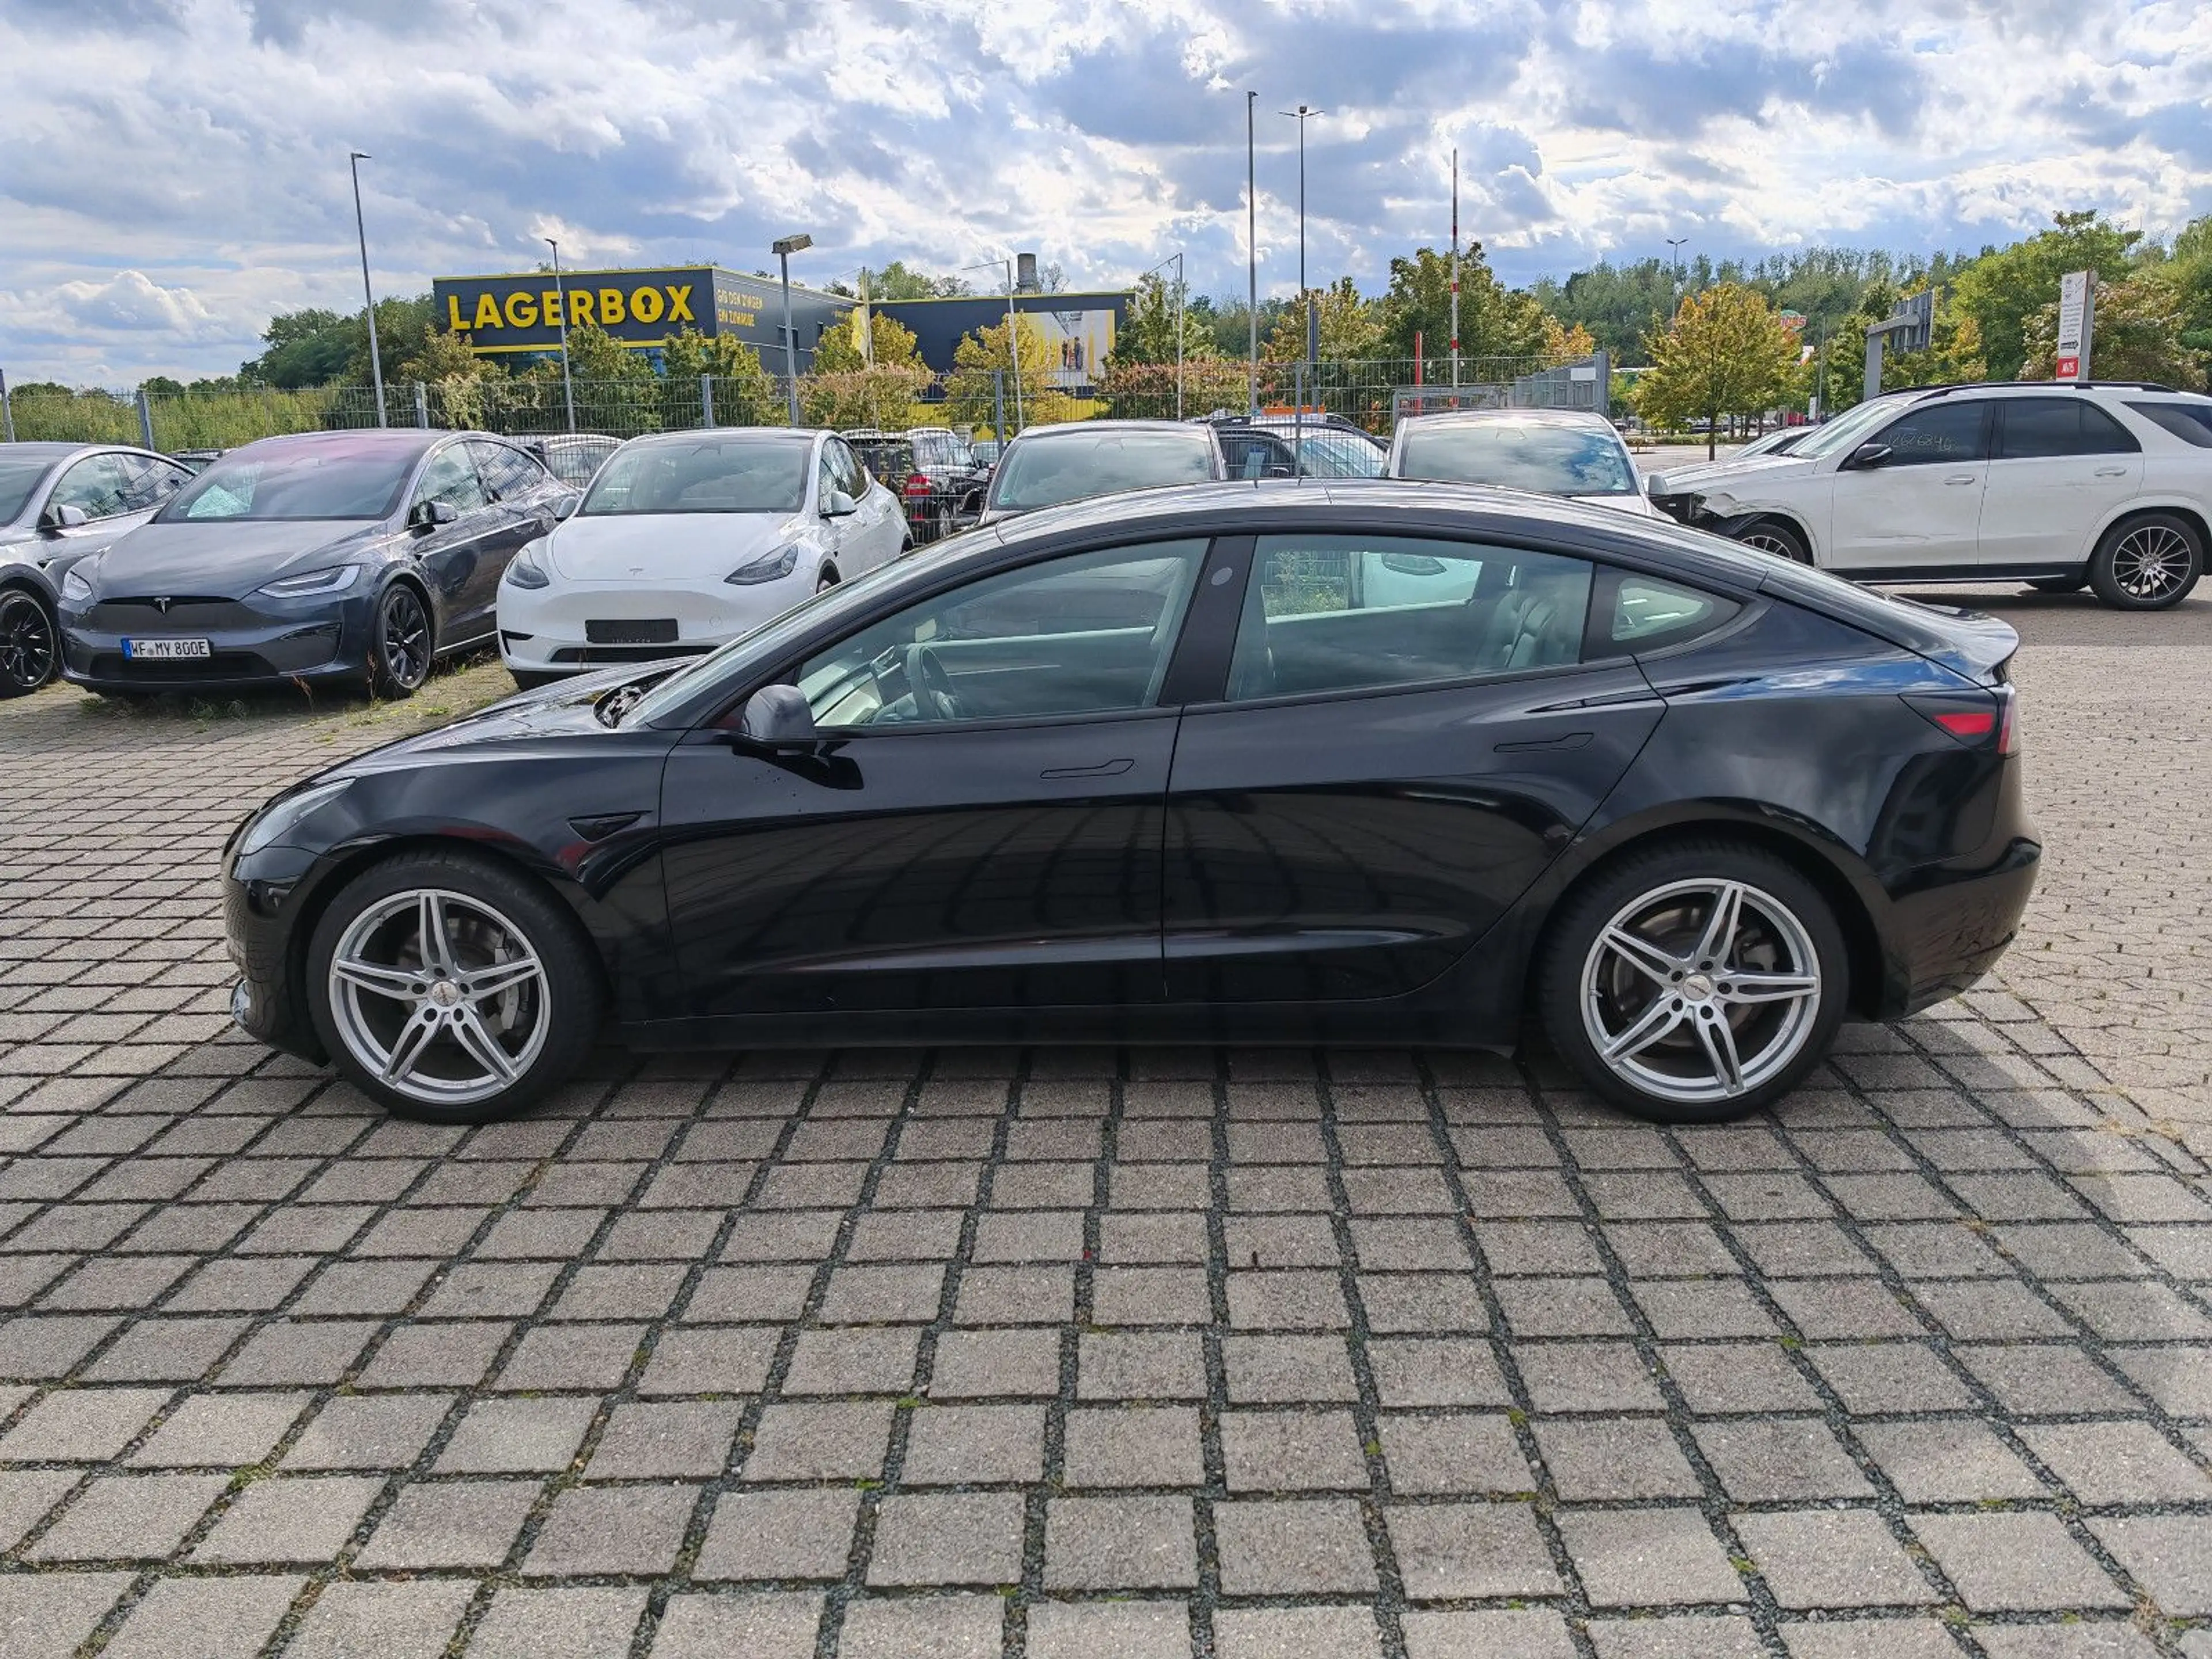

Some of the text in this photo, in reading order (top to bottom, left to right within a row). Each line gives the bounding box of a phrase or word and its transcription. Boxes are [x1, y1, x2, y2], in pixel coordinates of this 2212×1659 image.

[448, 285, 695, 329] LAGERBOX
[132, 641, 146, 655] WF
[155, 641, 171, 656] MY
[174, 641, 208, 655] 800E
